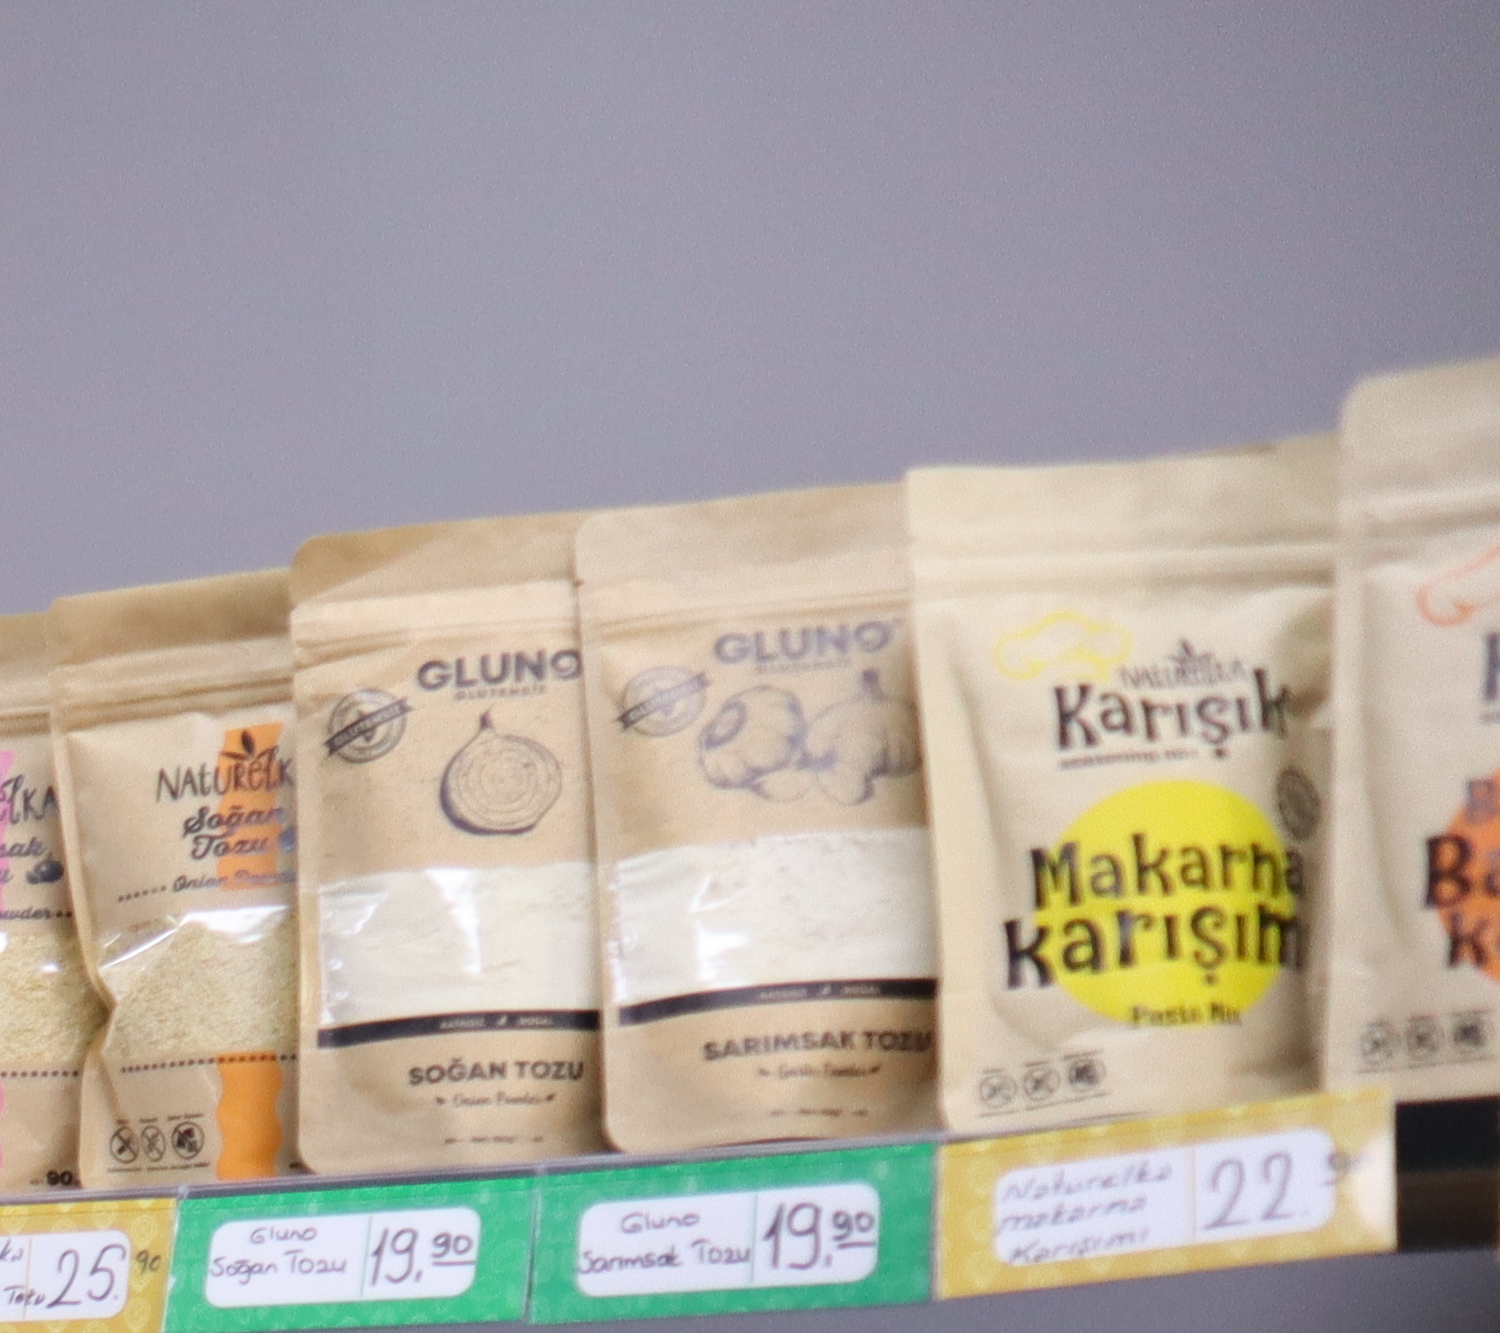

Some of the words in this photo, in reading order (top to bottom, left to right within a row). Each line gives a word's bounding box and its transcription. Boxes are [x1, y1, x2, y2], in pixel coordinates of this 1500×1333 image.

[713, 620, 889, 668] GLUNO
[417, 645, 582, 694] GLUNO
[1052, 665, 1294, 759] Karışık
[191, 837, 269, 861] Tozu
[702, 1028, 858, 1064] SARIMSAK
[408, 1056, 505, 1090] SOĞAN
[509, 1054, 585, 1083] TOZU
[249, 1224, 318, 1244] Gluno
[618, 1209, 702, 1234] Gluno
